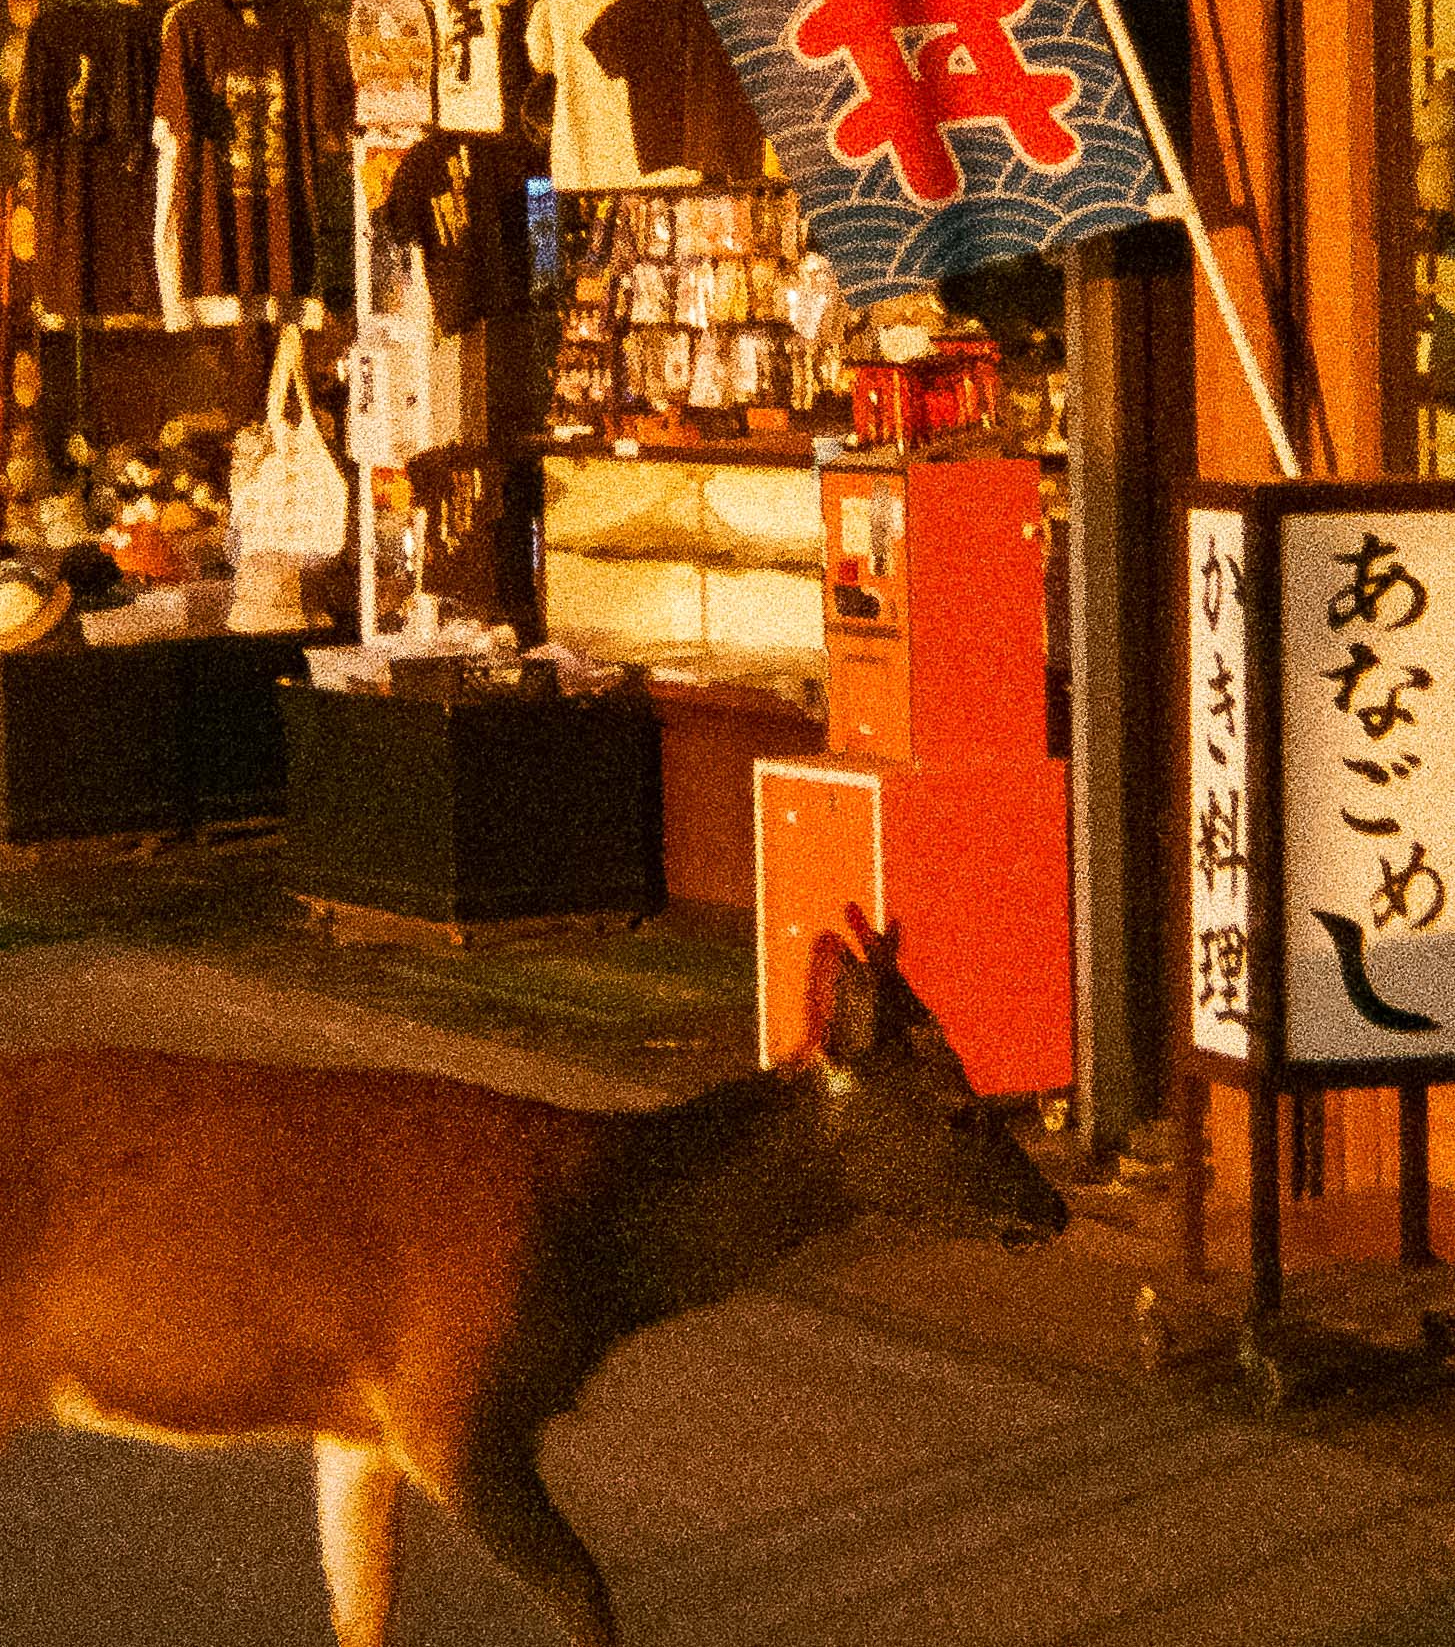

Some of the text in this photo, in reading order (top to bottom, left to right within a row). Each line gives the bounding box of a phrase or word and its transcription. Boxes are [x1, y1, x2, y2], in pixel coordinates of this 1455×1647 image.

[1313, 533, 1445, 1032] あなごめし
